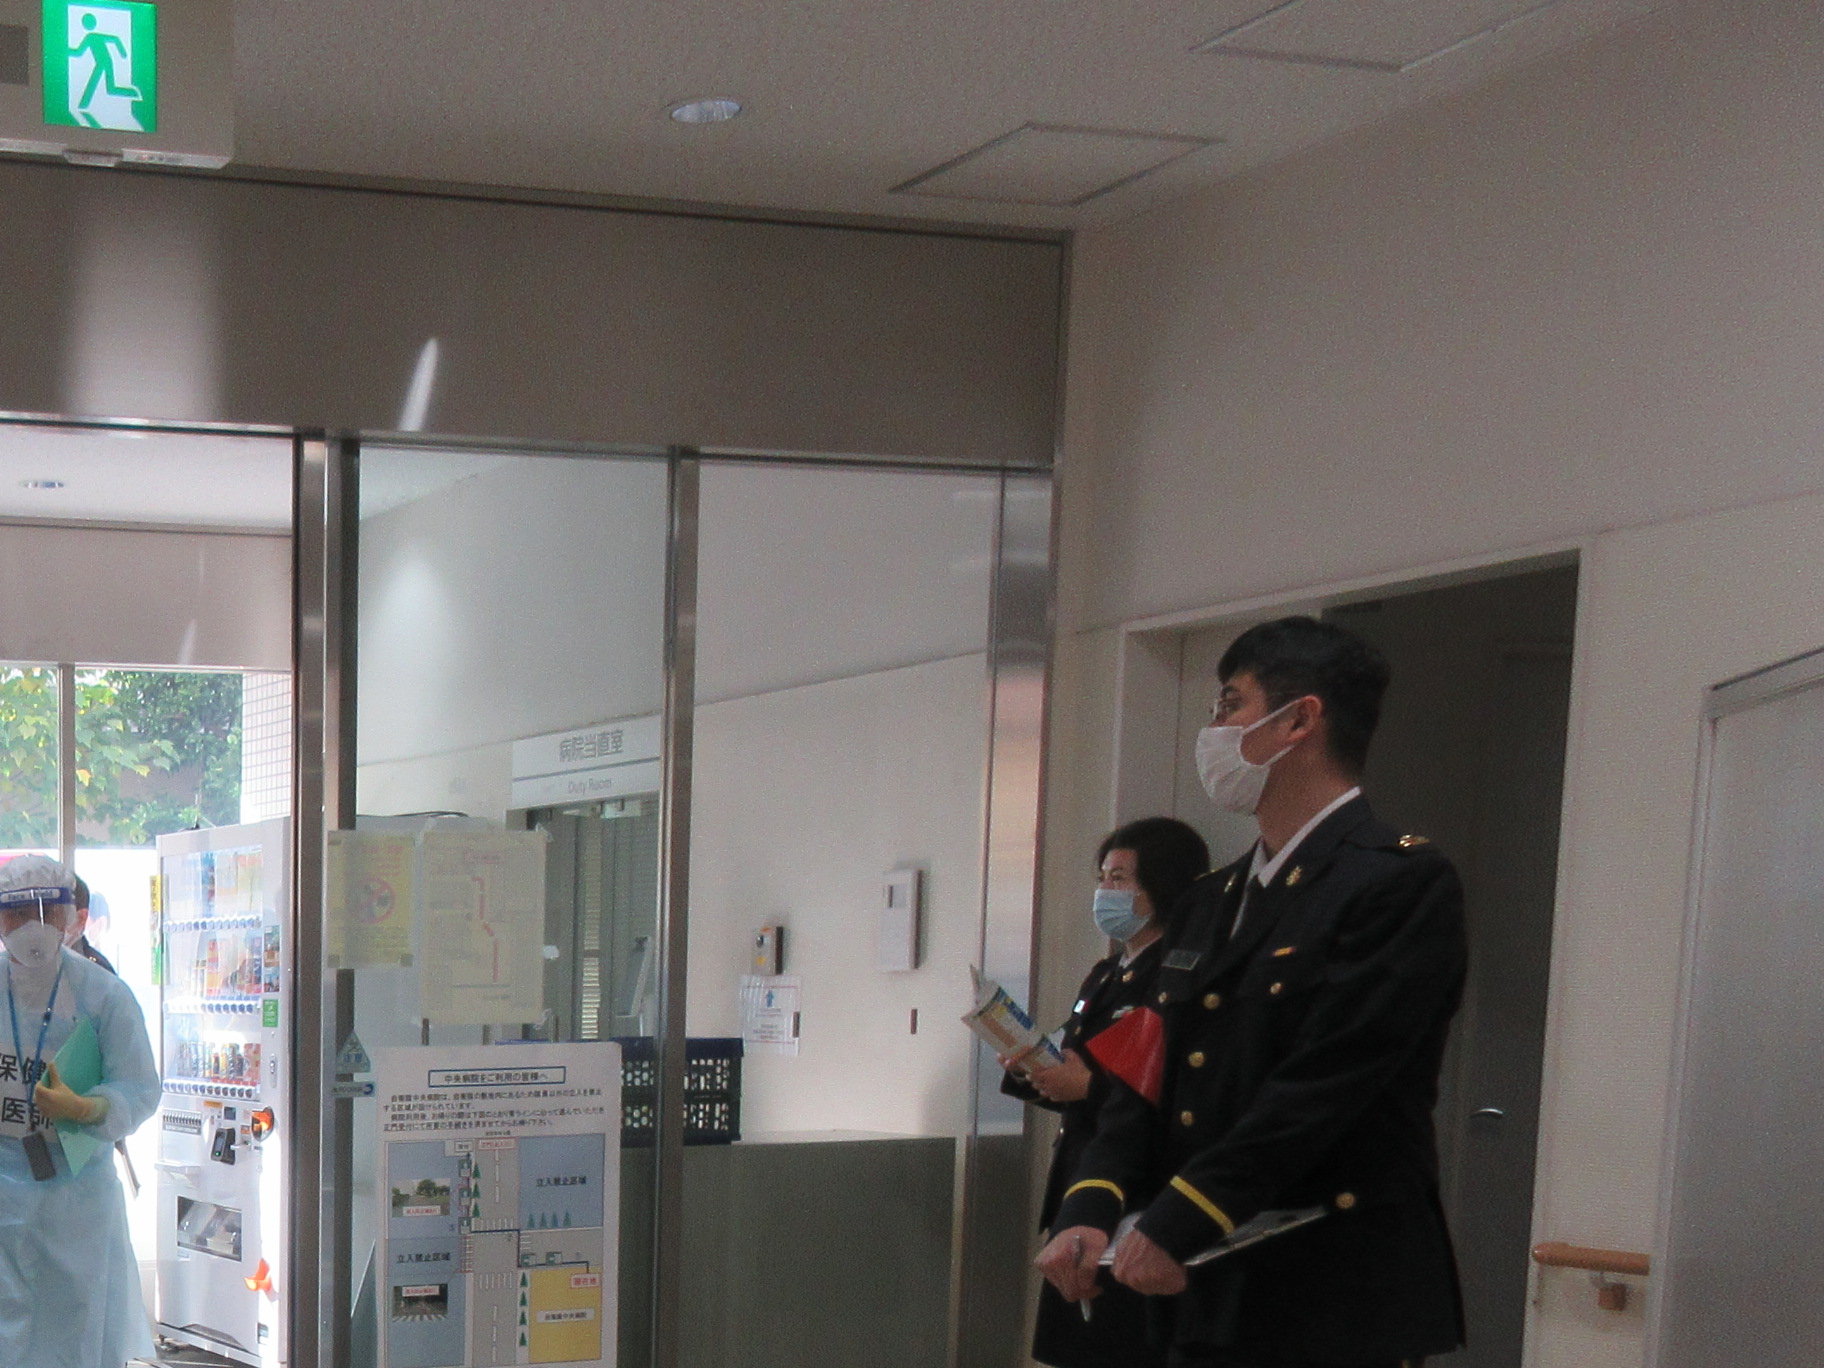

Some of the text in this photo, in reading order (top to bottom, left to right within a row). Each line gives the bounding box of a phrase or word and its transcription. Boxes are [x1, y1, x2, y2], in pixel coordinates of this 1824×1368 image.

[560, 730, 624, 762] 病院当直室
